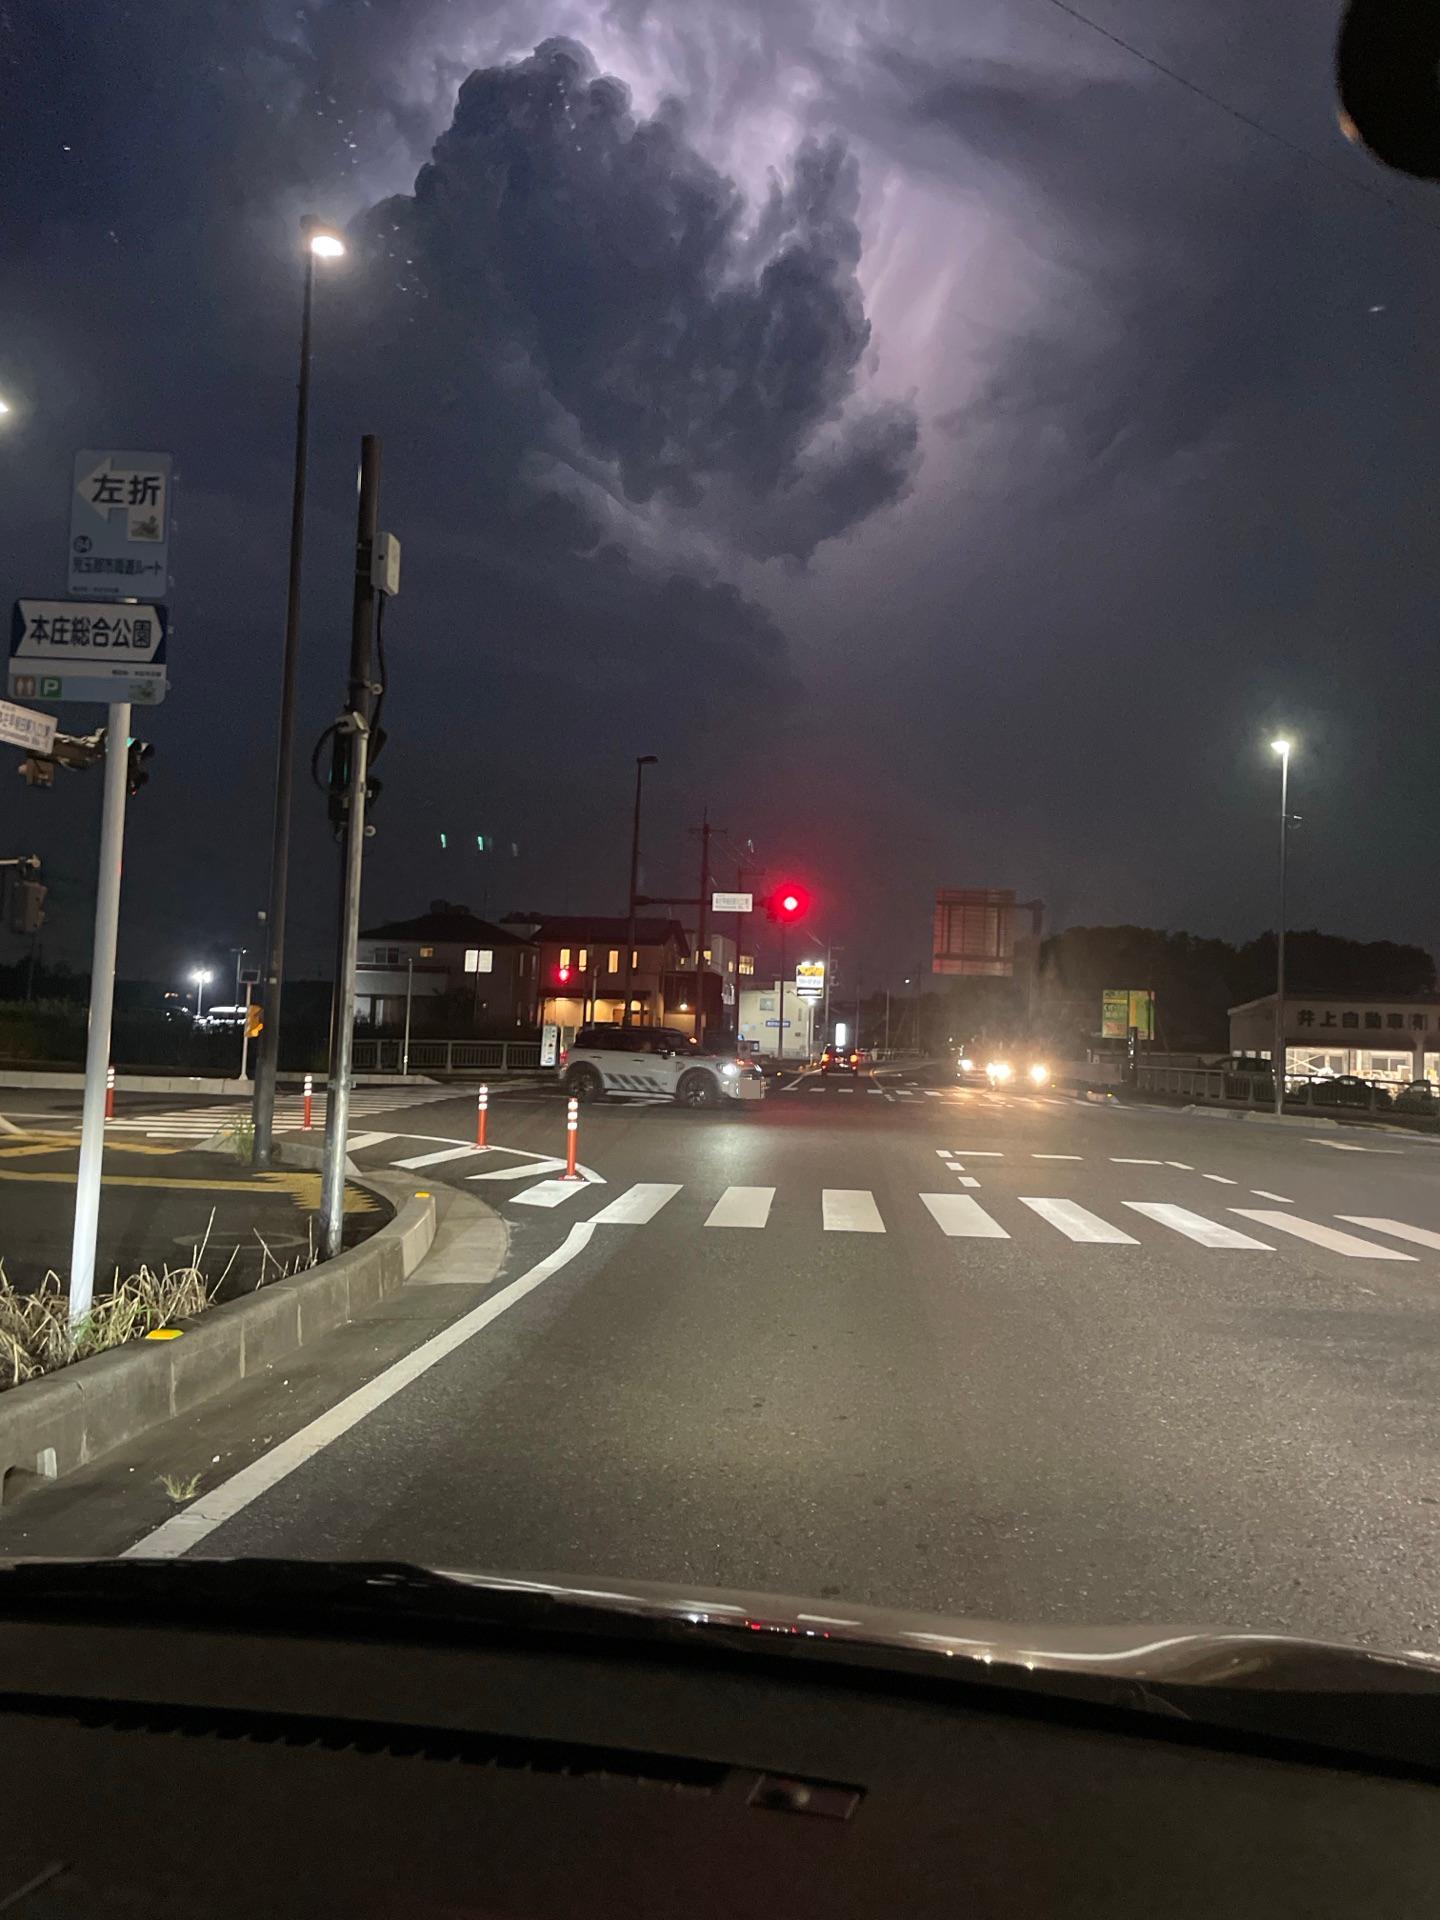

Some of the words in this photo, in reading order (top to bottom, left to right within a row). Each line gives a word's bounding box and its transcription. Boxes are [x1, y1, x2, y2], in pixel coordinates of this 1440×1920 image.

[92, 474, 162, 506] 左折
[30, 614, 152, 649] 本庄総合公園
[43, 678, 60, 697] P
